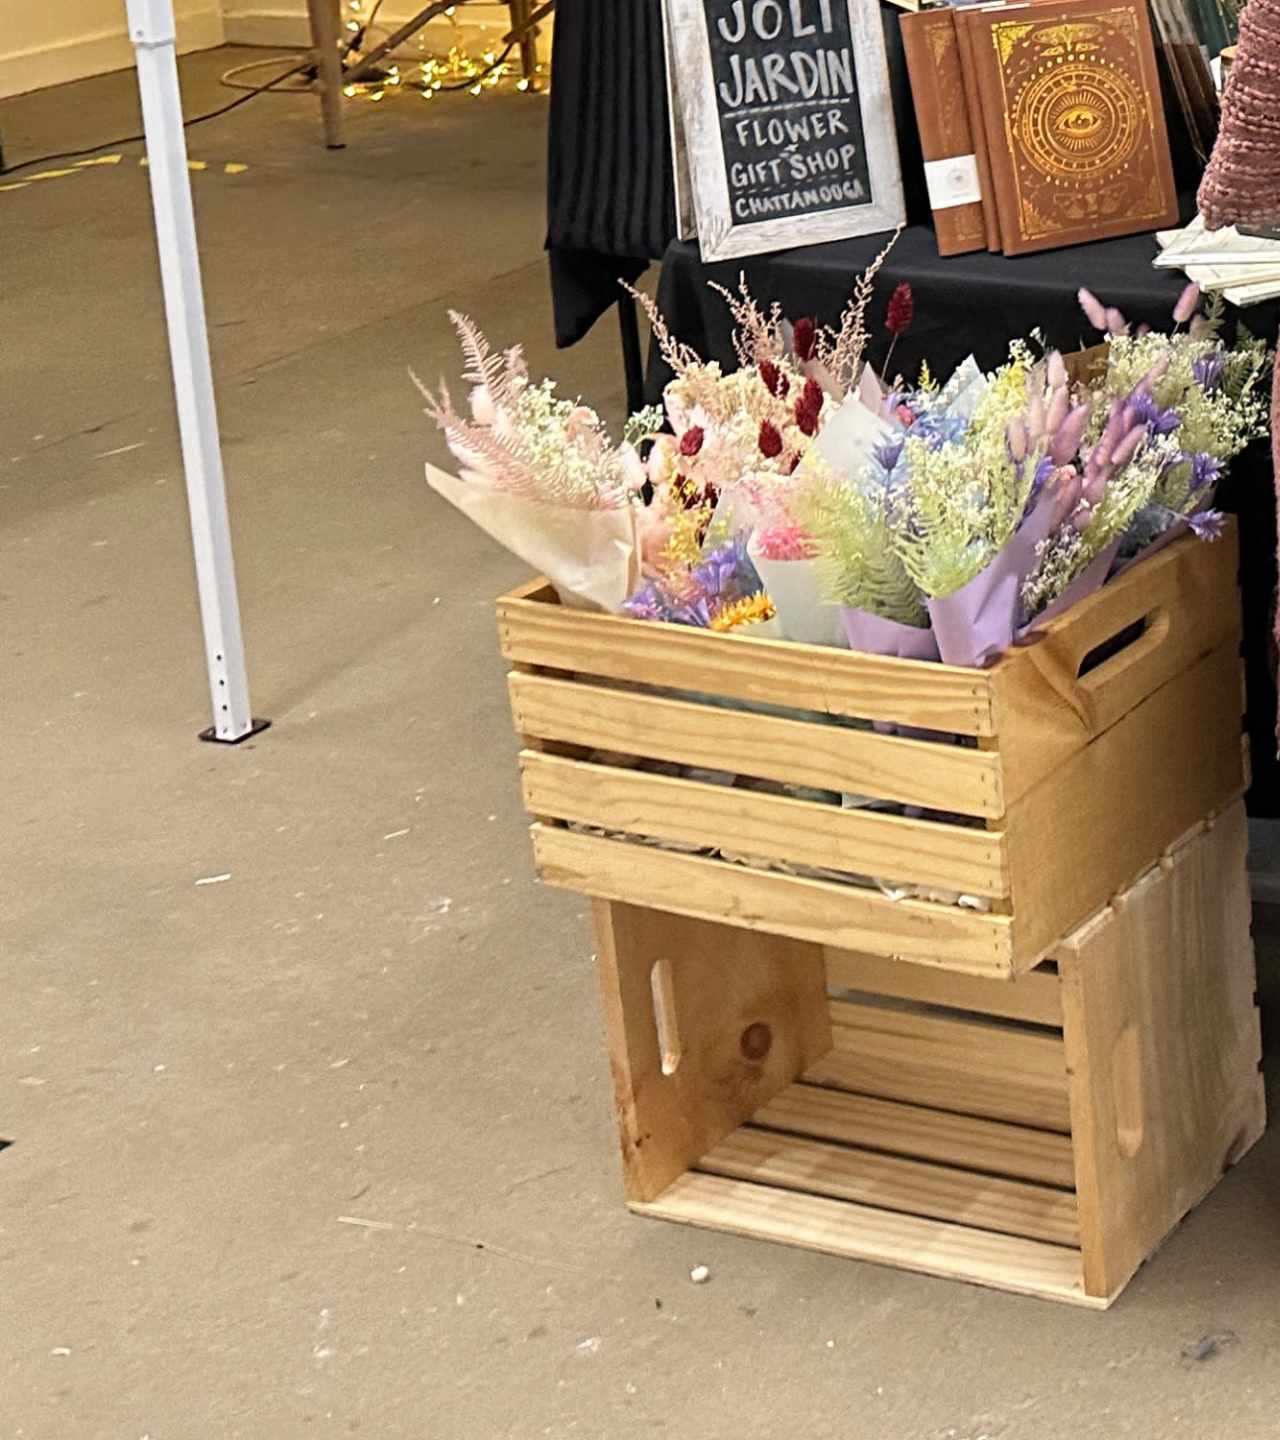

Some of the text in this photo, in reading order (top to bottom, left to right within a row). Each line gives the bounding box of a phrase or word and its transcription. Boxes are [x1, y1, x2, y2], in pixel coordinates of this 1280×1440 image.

[719, 48, 854, 108] JARDIN
[735, 108, 848, 147] FLOWER
[731, 143, 855, 187] GIFT SHOP
[735, 178, 864, 217] CHATTANOOGA
